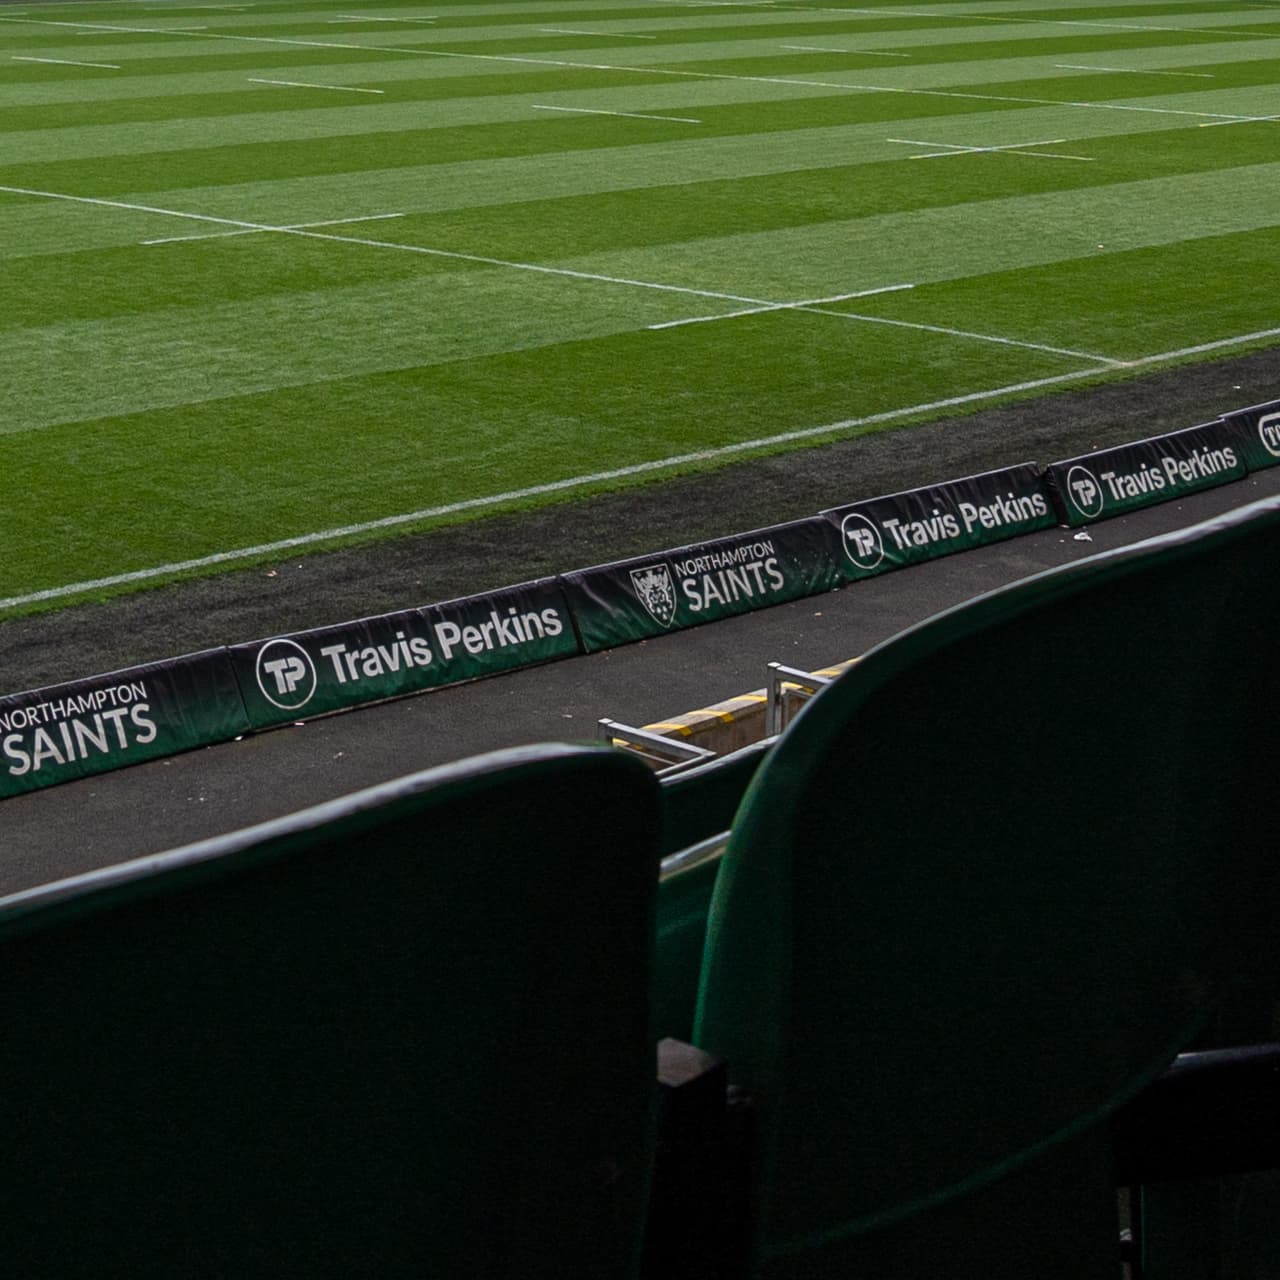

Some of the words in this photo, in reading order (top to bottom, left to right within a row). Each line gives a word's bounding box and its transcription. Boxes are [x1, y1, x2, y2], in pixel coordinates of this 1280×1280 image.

[1101, 465, 1165, 501] Travis
[1165, 444, 1237, 487] Perkins
[883, 509, 959, 550] Travis
[959, 493, 1047, 536] Perkins
[674, 539, 775, 579] NORTHAMPTON
[682, 558, 785, 612] SAINTS
[322, 631, 433, 684] Travis
[434, 606, 563, 660] Perkins
[2, 702, 158, 777] SAINTS
